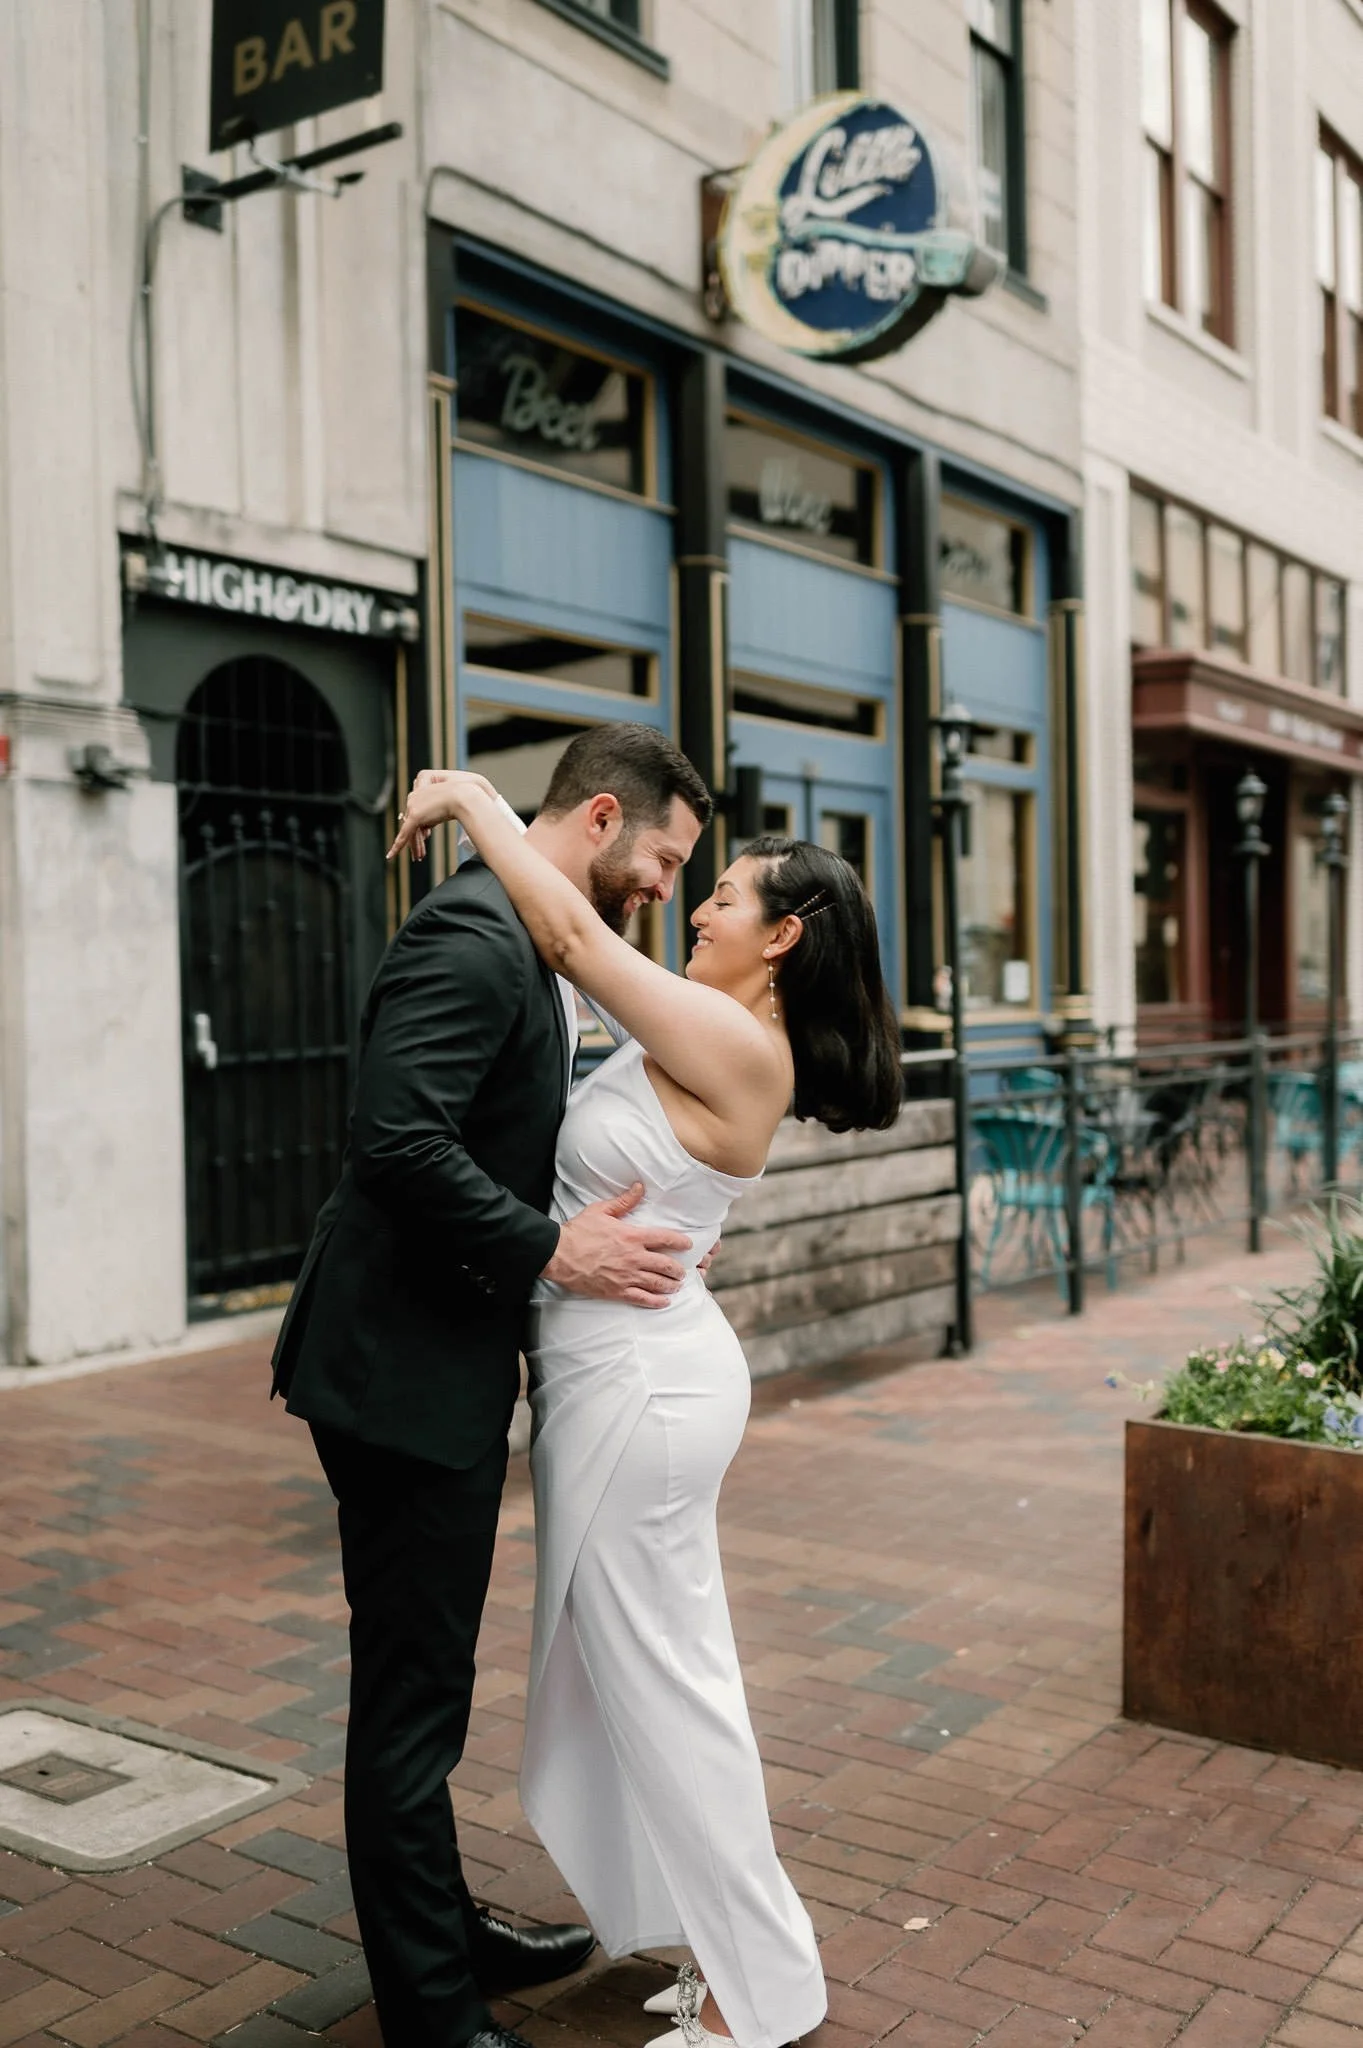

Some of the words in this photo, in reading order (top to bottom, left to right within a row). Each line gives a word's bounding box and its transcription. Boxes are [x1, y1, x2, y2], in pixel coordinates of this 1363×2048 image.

[233, 0, 357, 97] BAR
[777, 239, 916, 300] DIPPER
[502, 354, 598, 450] Beer
